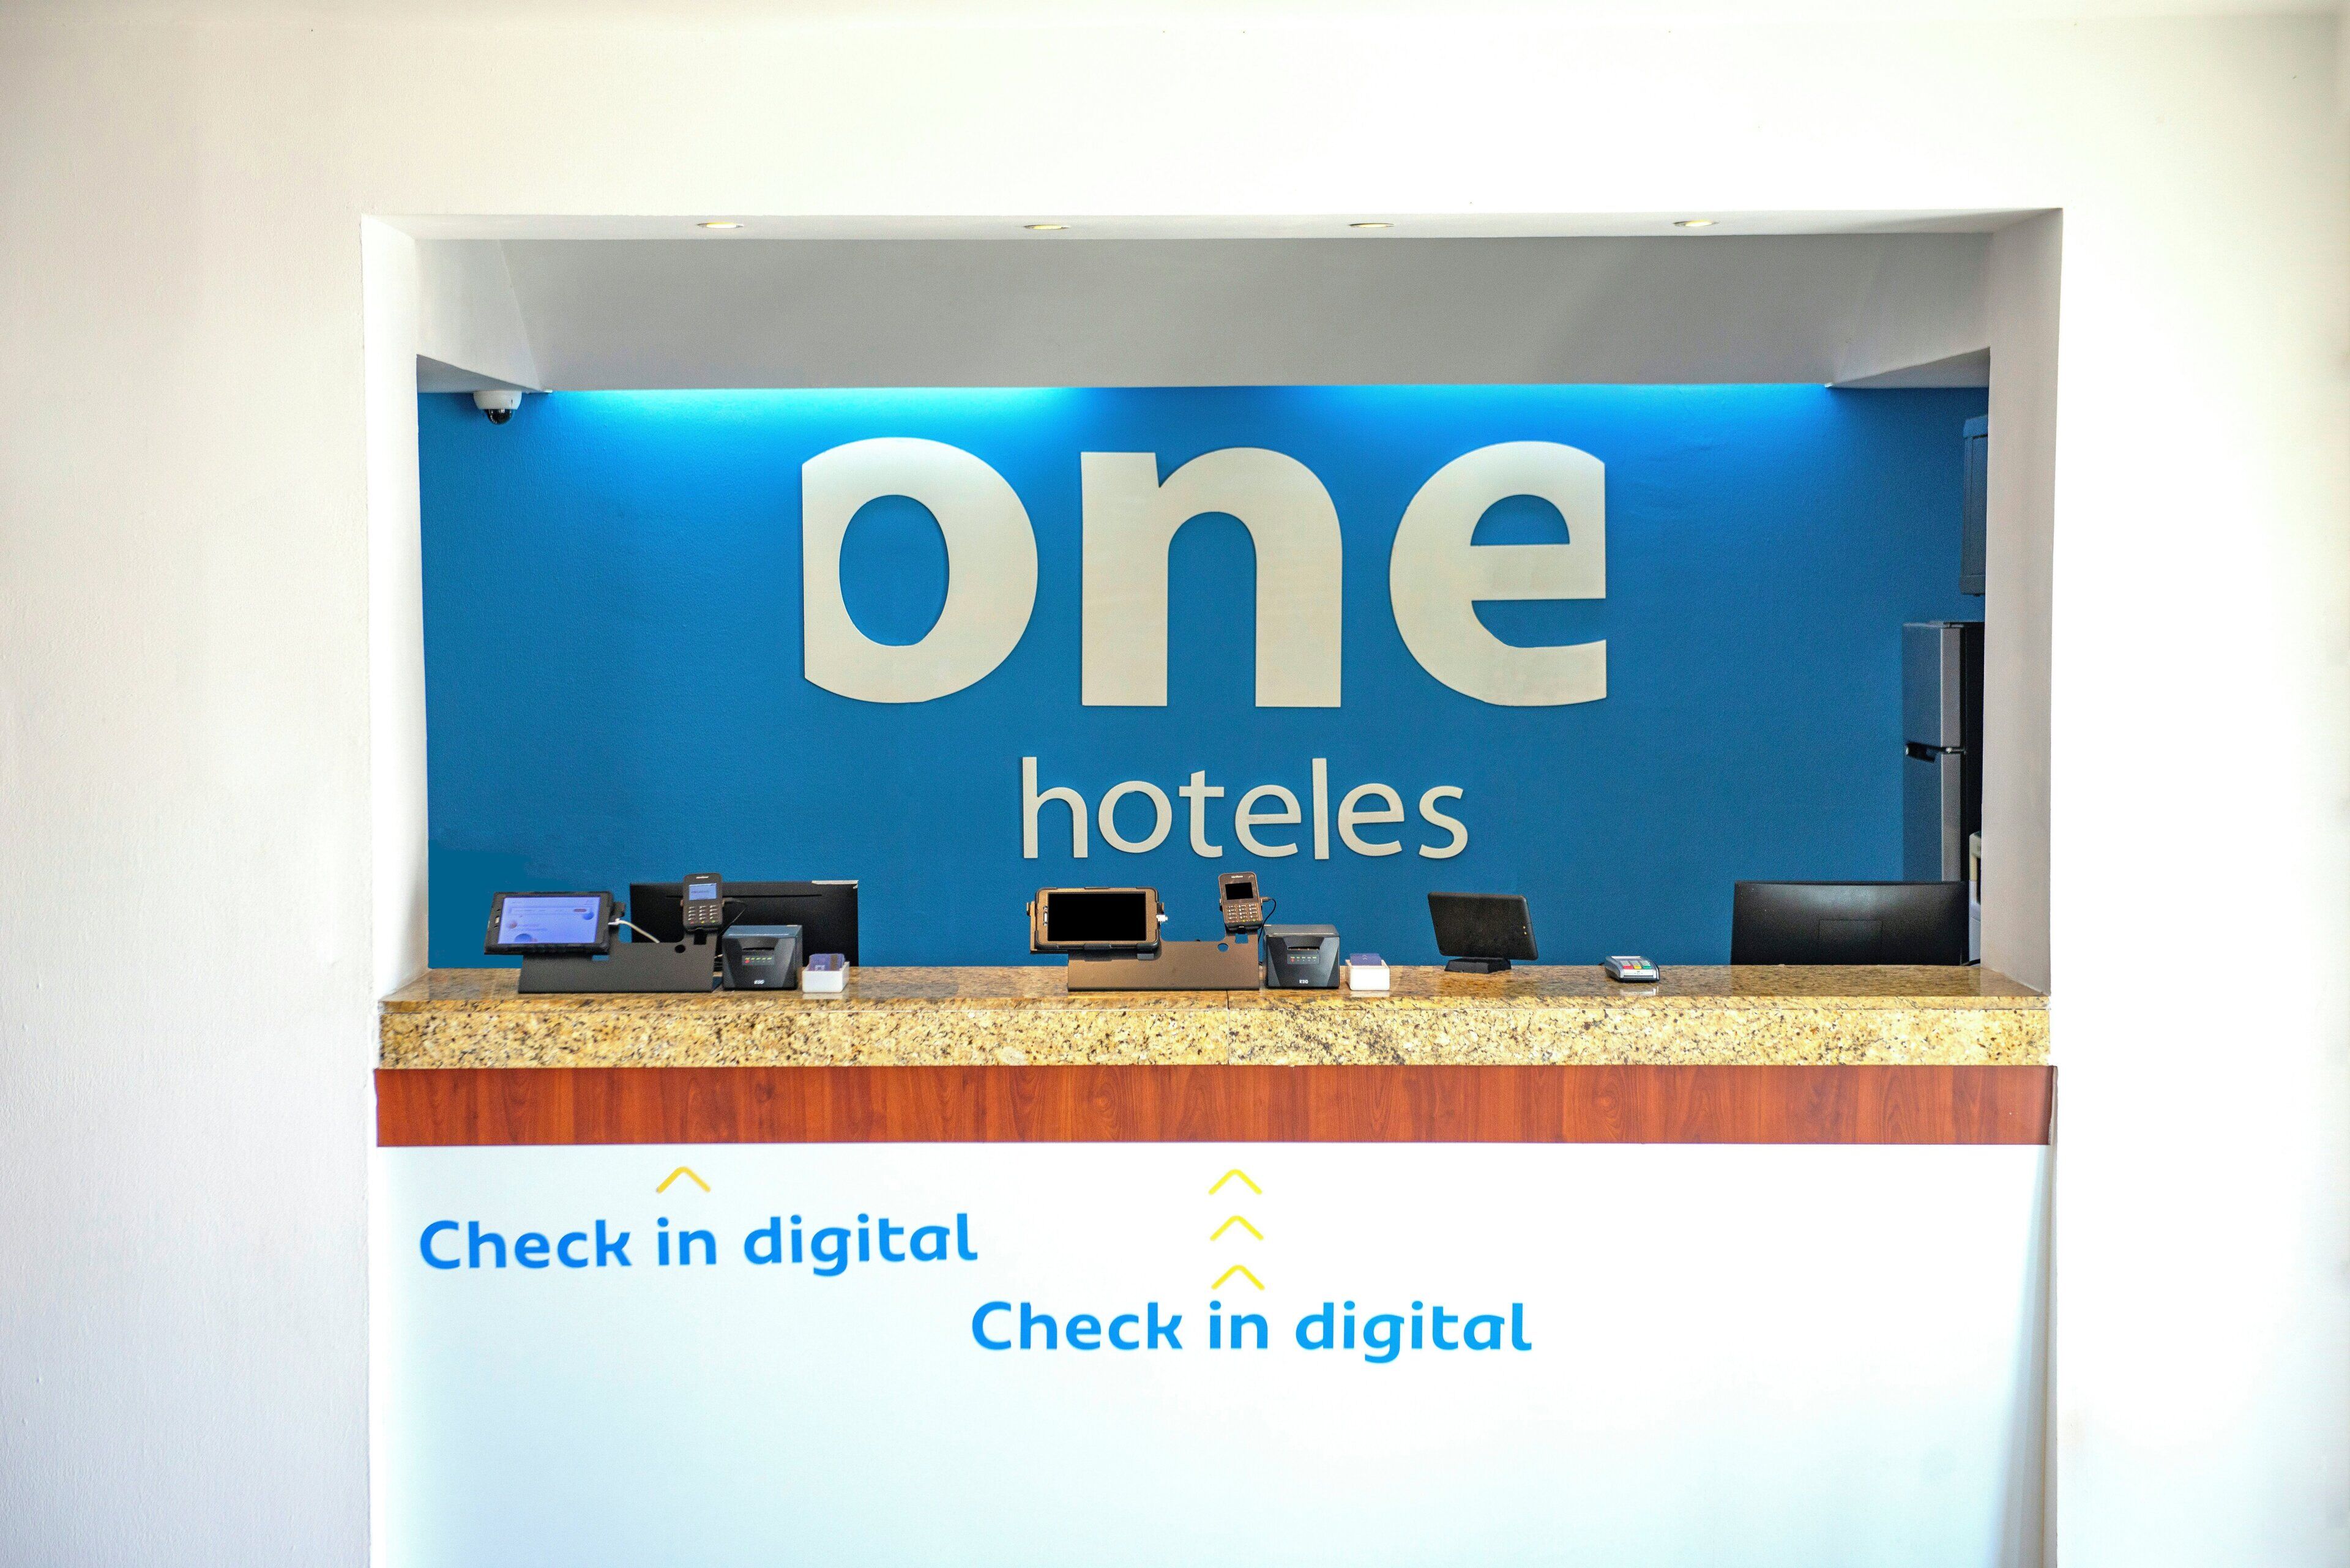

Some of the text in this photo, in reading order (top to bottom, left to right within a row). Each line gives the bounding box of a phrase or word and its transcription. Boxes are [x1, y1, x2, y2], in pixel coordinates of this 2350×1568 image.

[801, 437, 1607, 707] one
[1022, 756, 1468, 860] hoteles
[419, 1212, 978, 1277] Check in digital
[972, 1300, 1532, 1364] Check in digital
